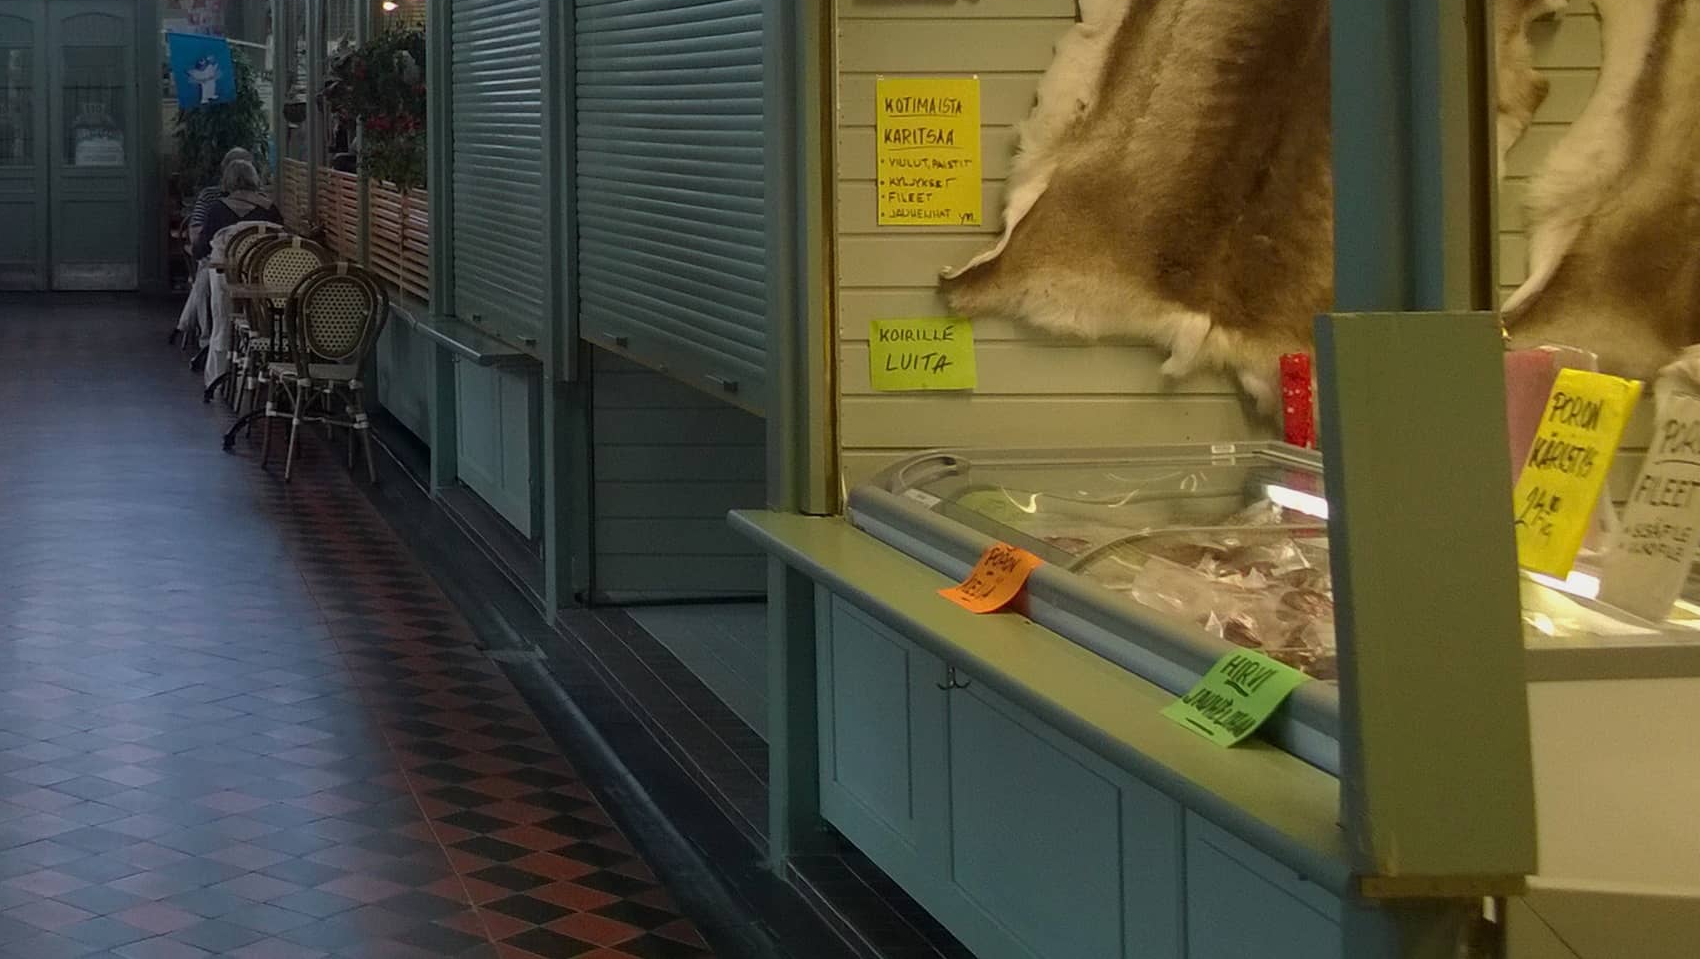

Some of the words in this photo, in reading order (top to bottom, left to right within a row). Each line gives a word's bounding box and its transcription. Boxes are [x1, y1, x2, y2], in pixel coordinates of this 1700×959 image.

[885, 97, 962, 114] KOTIMAISTA
[884, 127, 955, 145] KARITSAA
[888, 192, 933, 203] FILEET
[879, 325, 955, 342] KOIRILLE
[886, 352, 954, 375] LUITA
[1220, 654, 1278, 693] HIRVI
